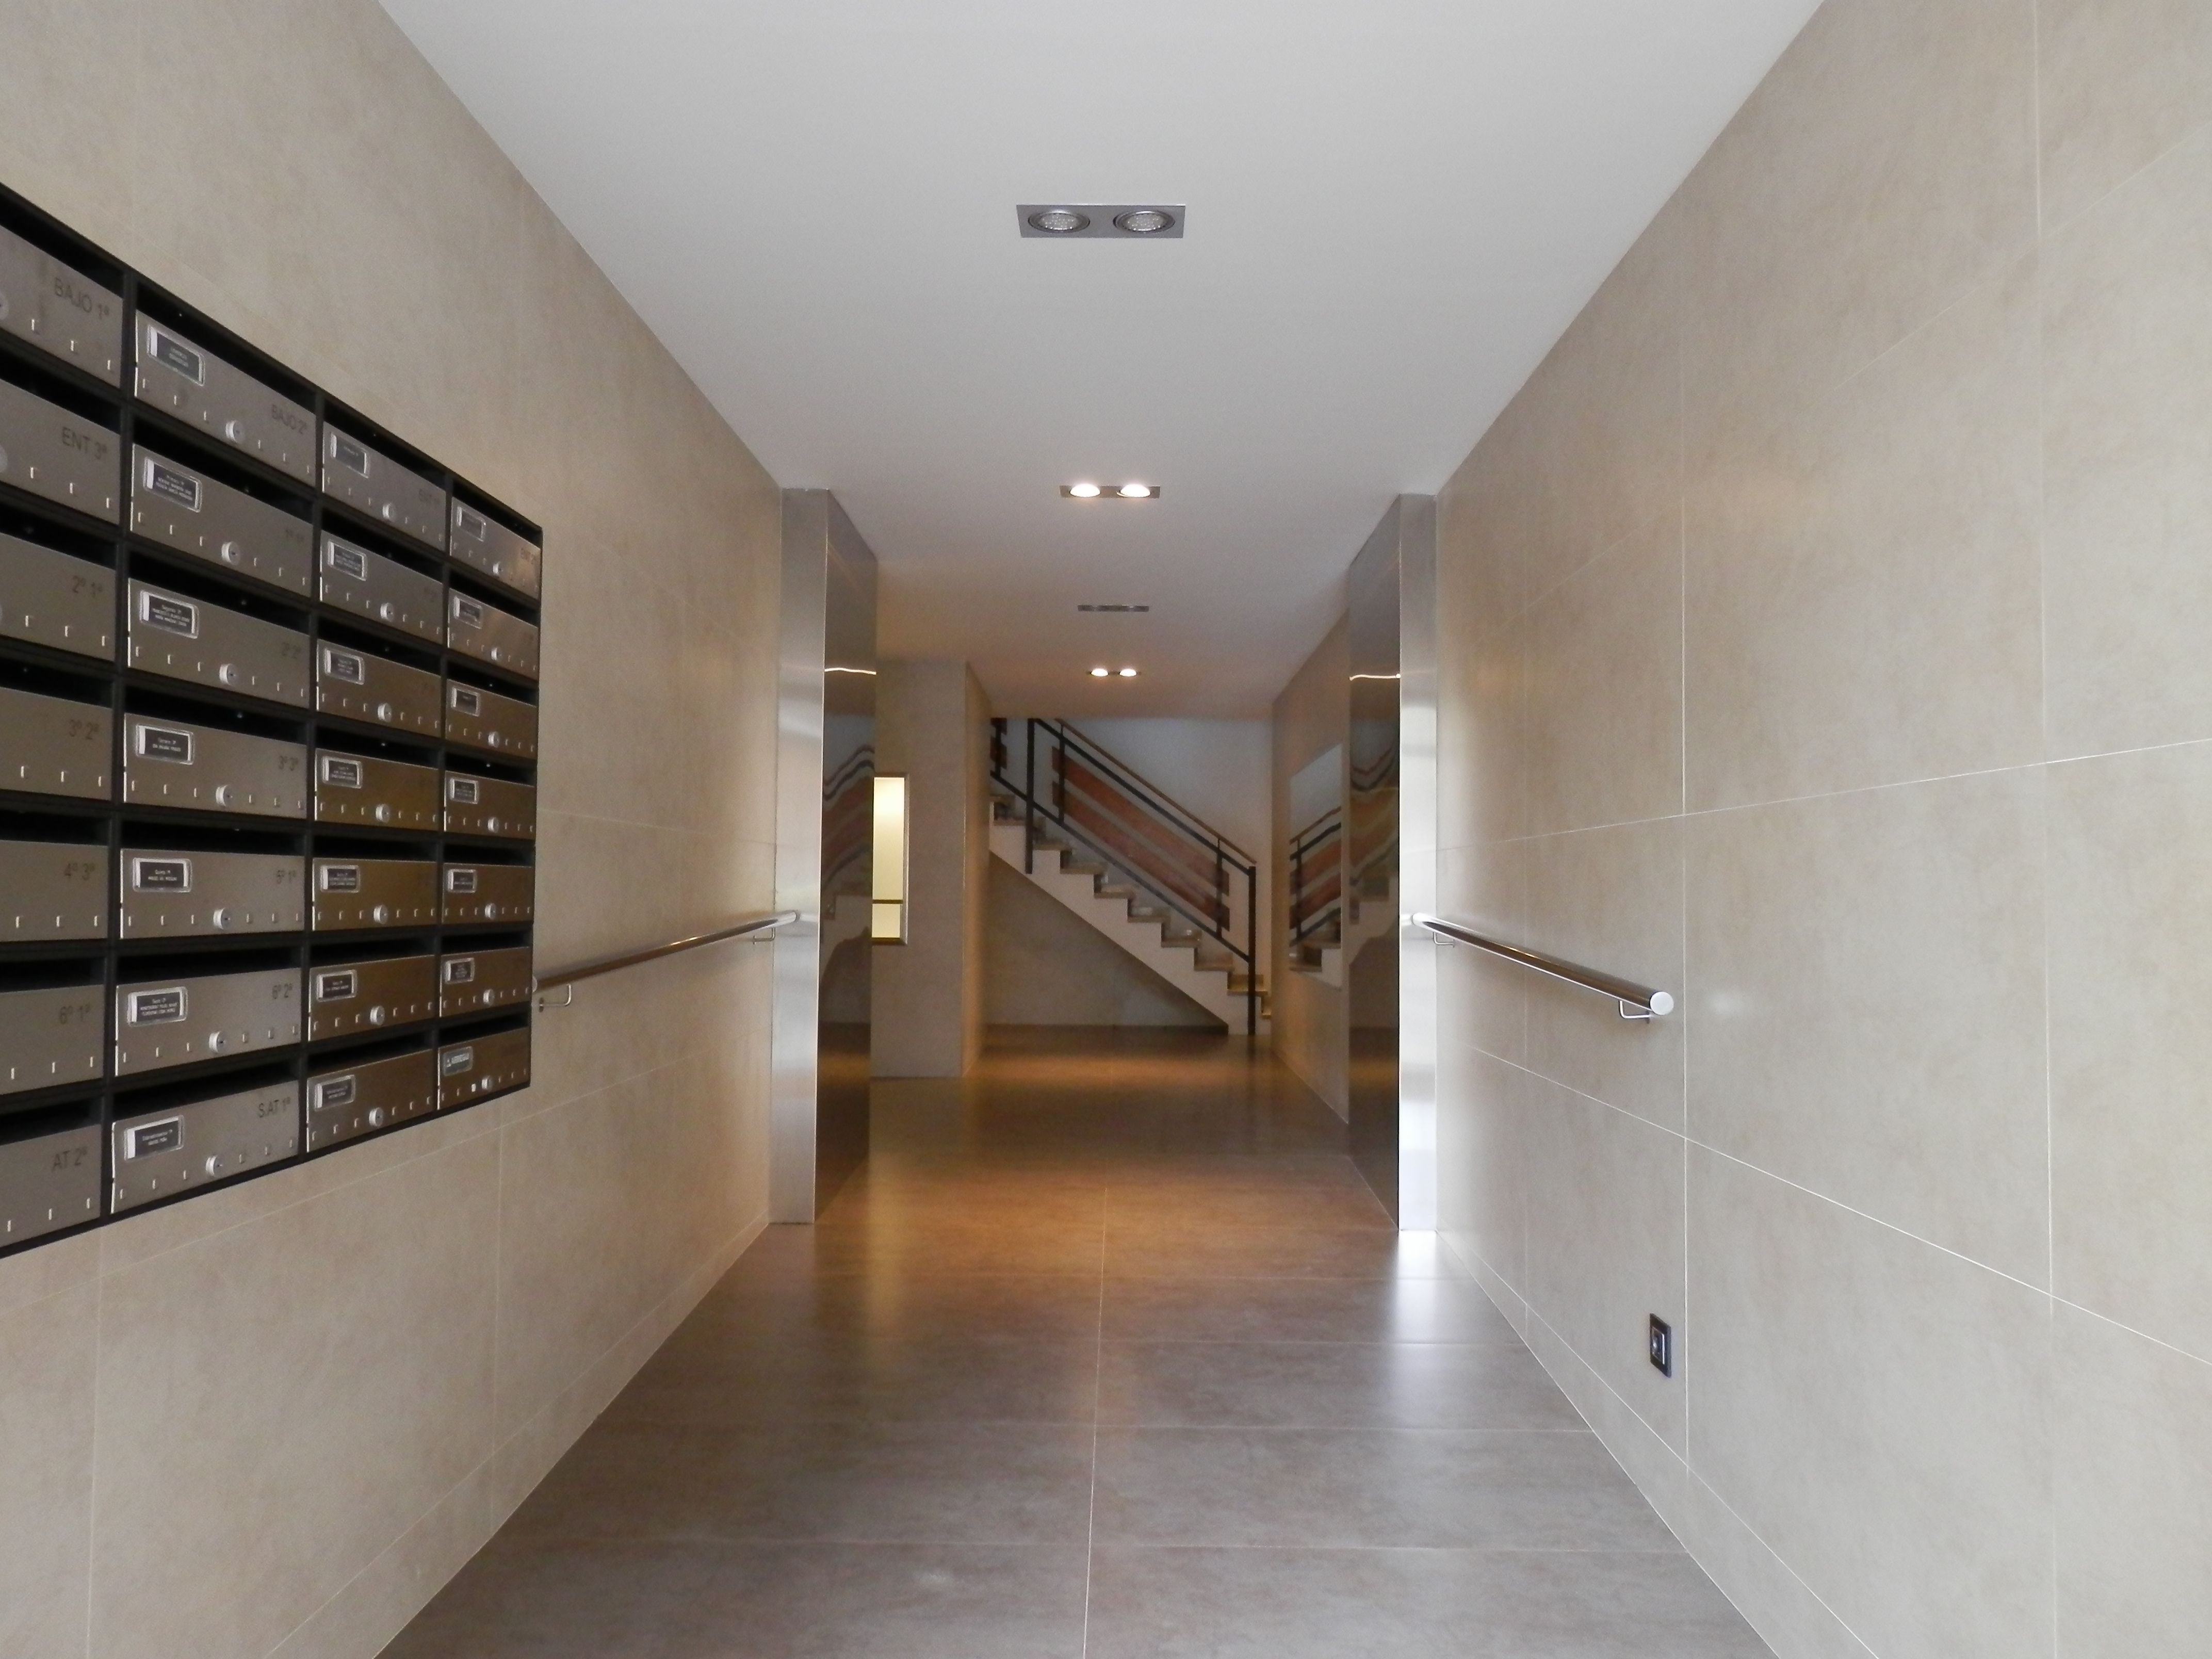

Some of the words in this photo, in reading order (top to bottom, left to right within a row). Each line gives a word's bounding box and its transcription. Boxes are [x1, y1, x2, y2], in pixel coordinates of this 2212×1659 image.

[54, 277, 92, 313] BAJO
[62, 426, 91, 454] ENT
[52, 1150, 70, 1172] AT
